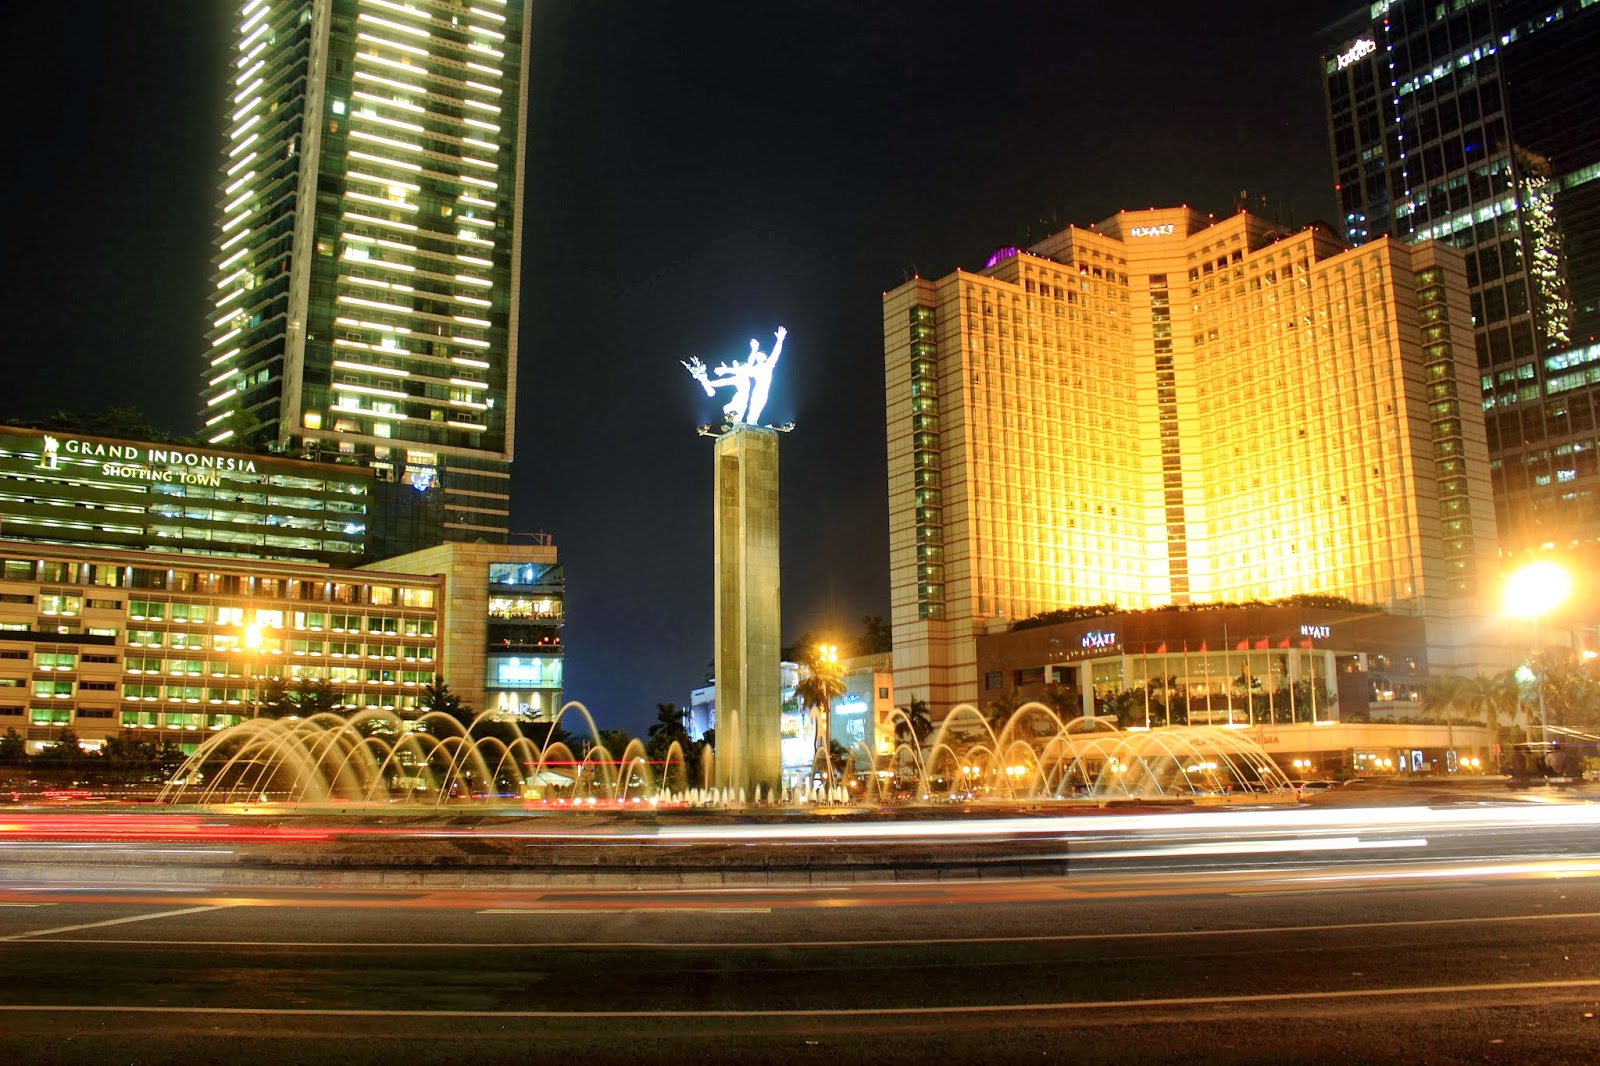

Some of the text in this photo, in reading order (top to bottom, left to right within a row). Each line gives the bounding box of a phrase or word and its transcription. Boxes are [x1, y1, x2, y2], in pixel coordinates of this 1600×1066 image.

[1131, 225, 1174, 237] HYATT
[65, 440, 256, 473] GRAND INDONESIA
[102, 463, 221, 487] SHOPPING TOWN
[1301, 625, 1330, 639] HYATT
[1082, 633, 1116, 648] HYATT
